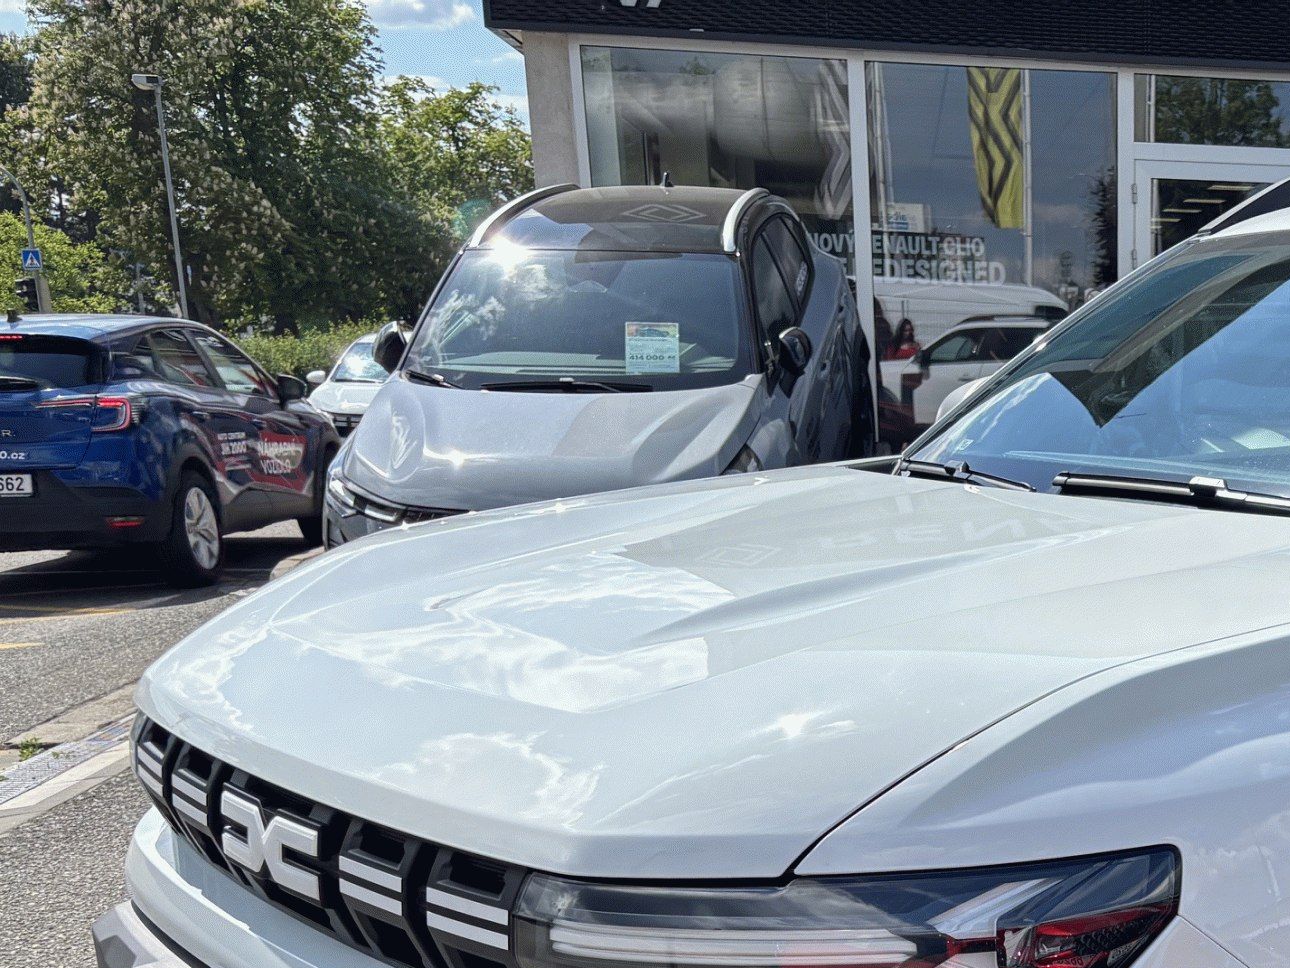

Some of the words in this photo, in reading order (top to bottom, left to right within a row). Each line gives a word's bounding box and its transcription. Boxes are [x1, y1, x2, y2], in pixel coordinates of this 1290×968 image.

[873, 235, 940, 255] ENAULT
[942, 237, 985, 257] CLIO
[873, 258, 1006, 285] EDESIGNED
